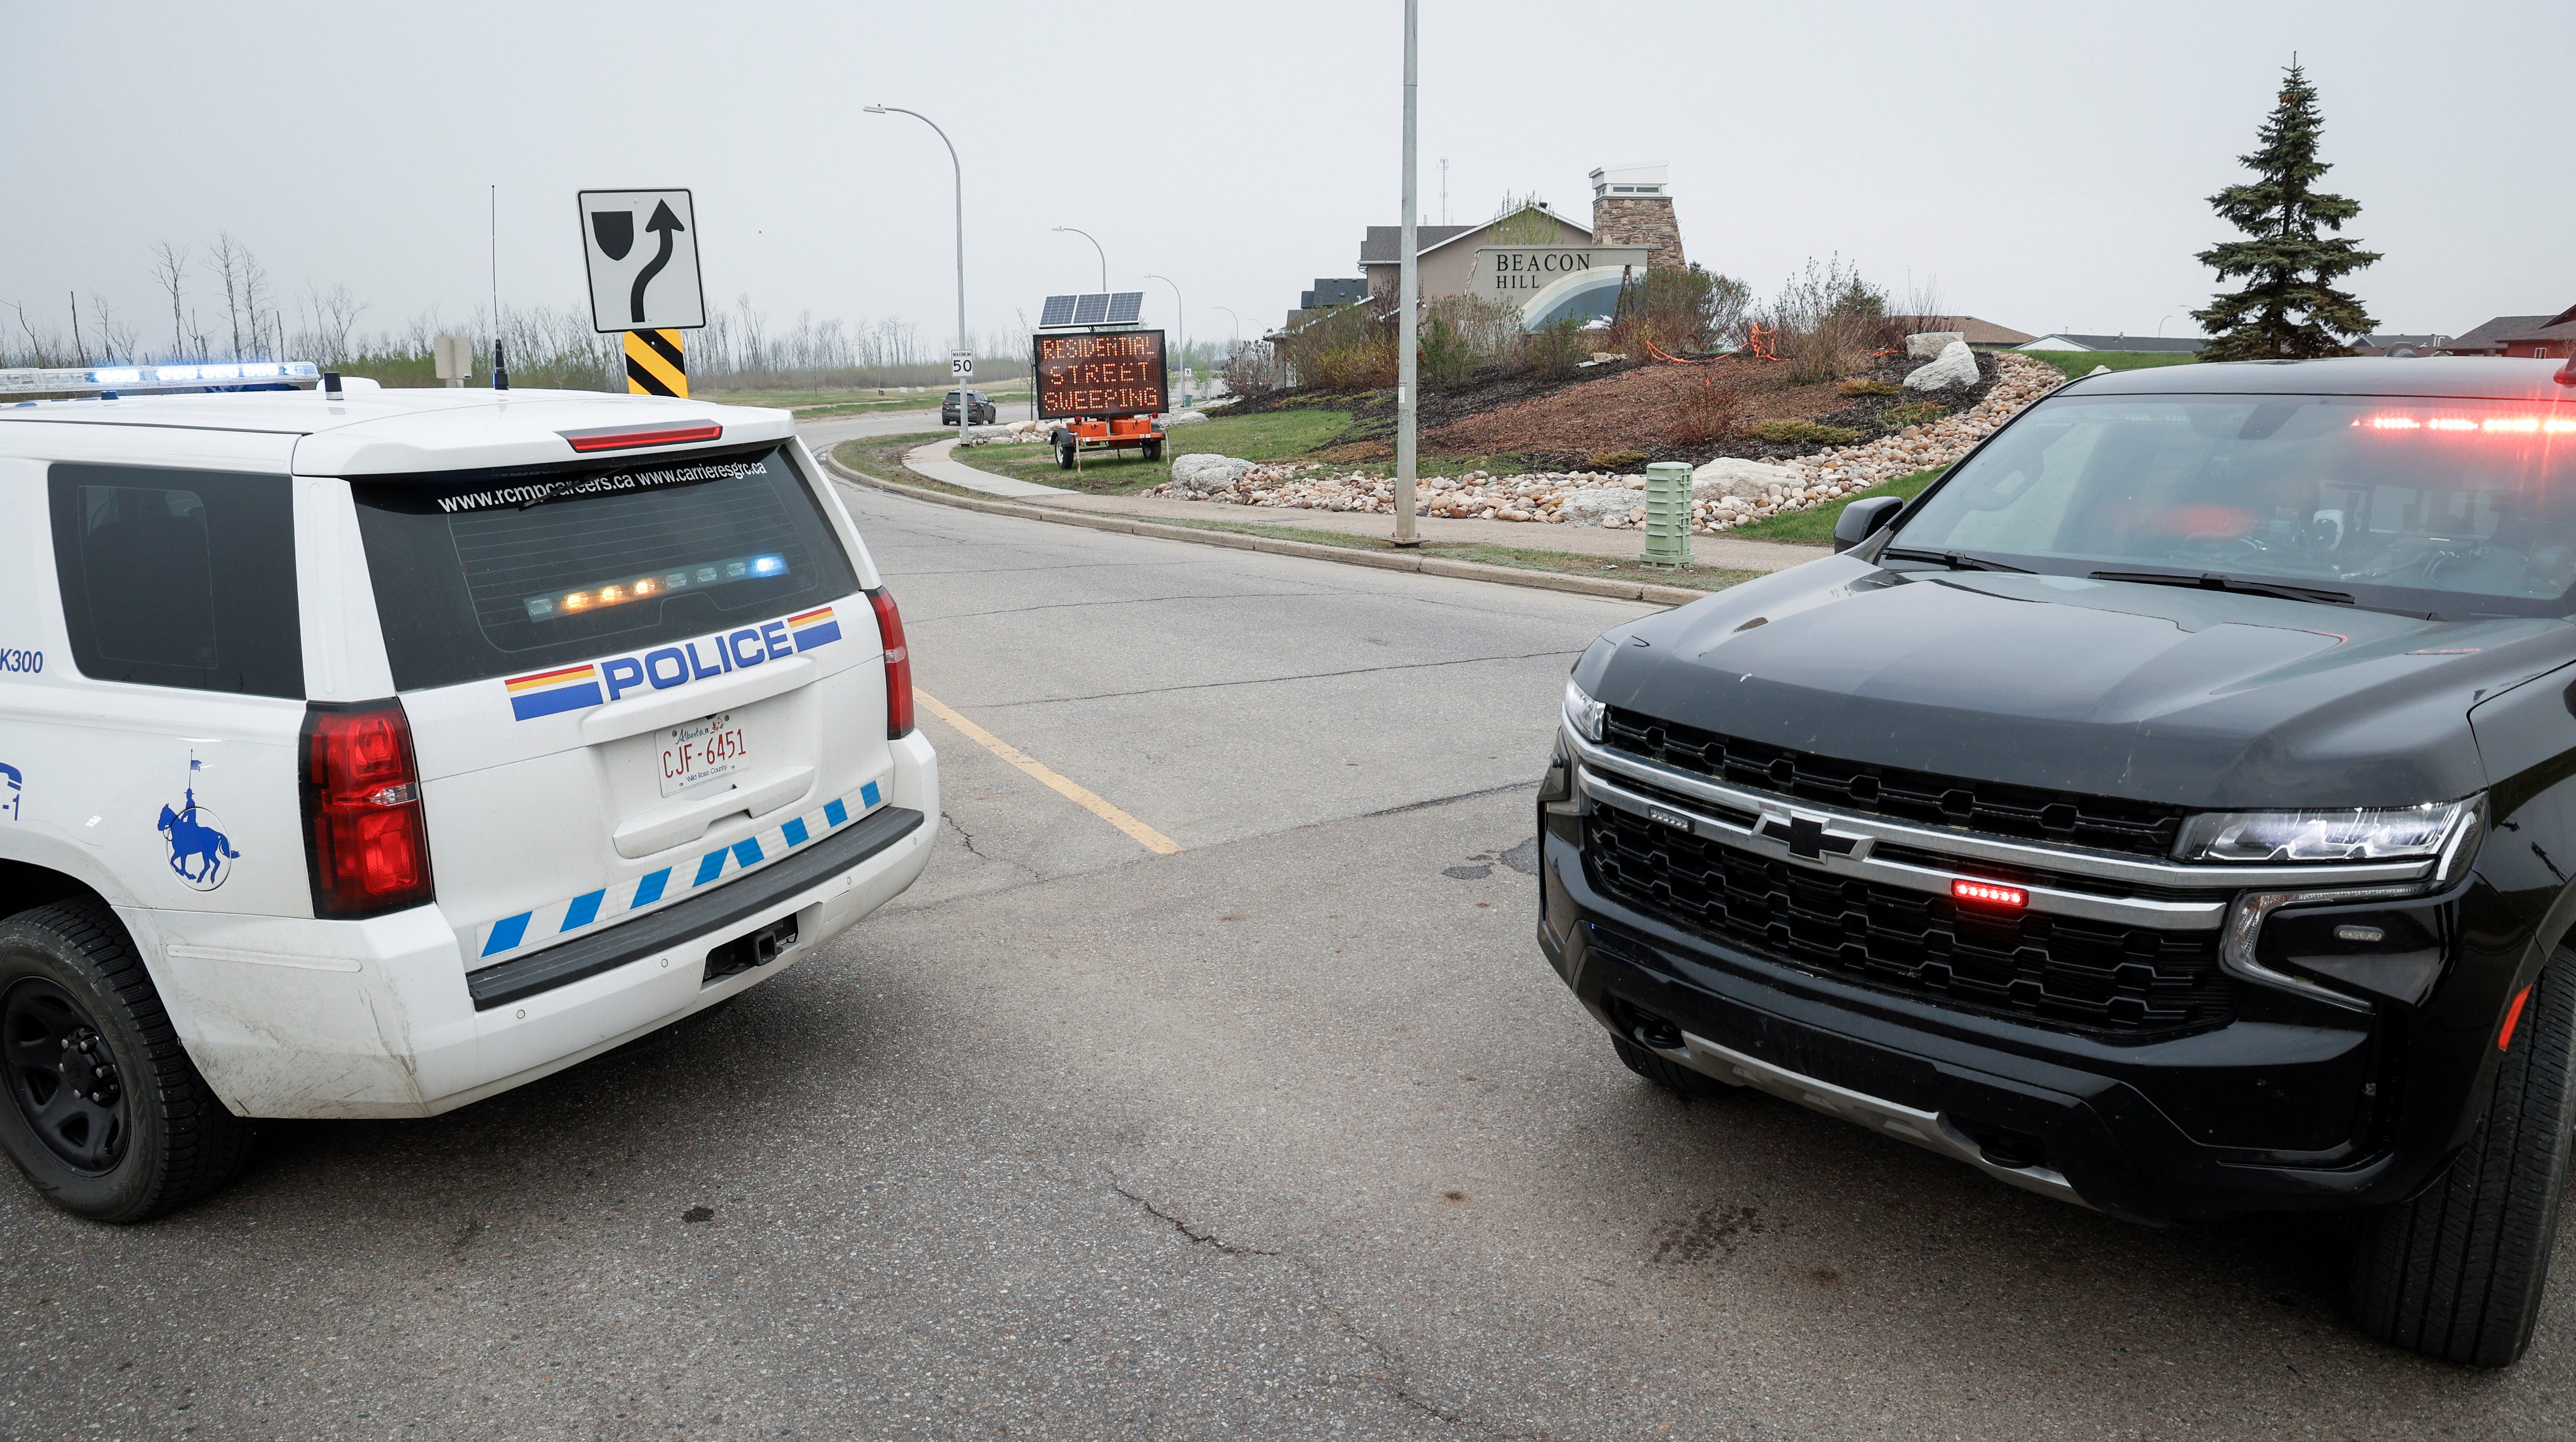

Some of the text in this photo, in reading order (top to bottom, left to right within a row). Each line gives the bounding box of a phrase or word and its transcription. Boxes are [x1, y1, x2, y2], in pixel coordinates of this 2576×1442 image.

[1496, 254, 1591, 272] BEACON
[1496, 275, 1539, 288] HILL
[1043, 336, 1154, 359] RESIDENTIAL
[953, 360, 972, 372] 50
[1050, 362, 1148, 385] STREET
[1044, 387, 1158, 411] SWEEPING
[635, 462, 768, 486] www.carrieresgrc.ca
[601, 621, 793, 701] POLICE
[675, 727, 706, 745] Alberta
[663, 728, 746, 778] CJF-6451
[686, 764, 728, 782] Wild Rose Country
